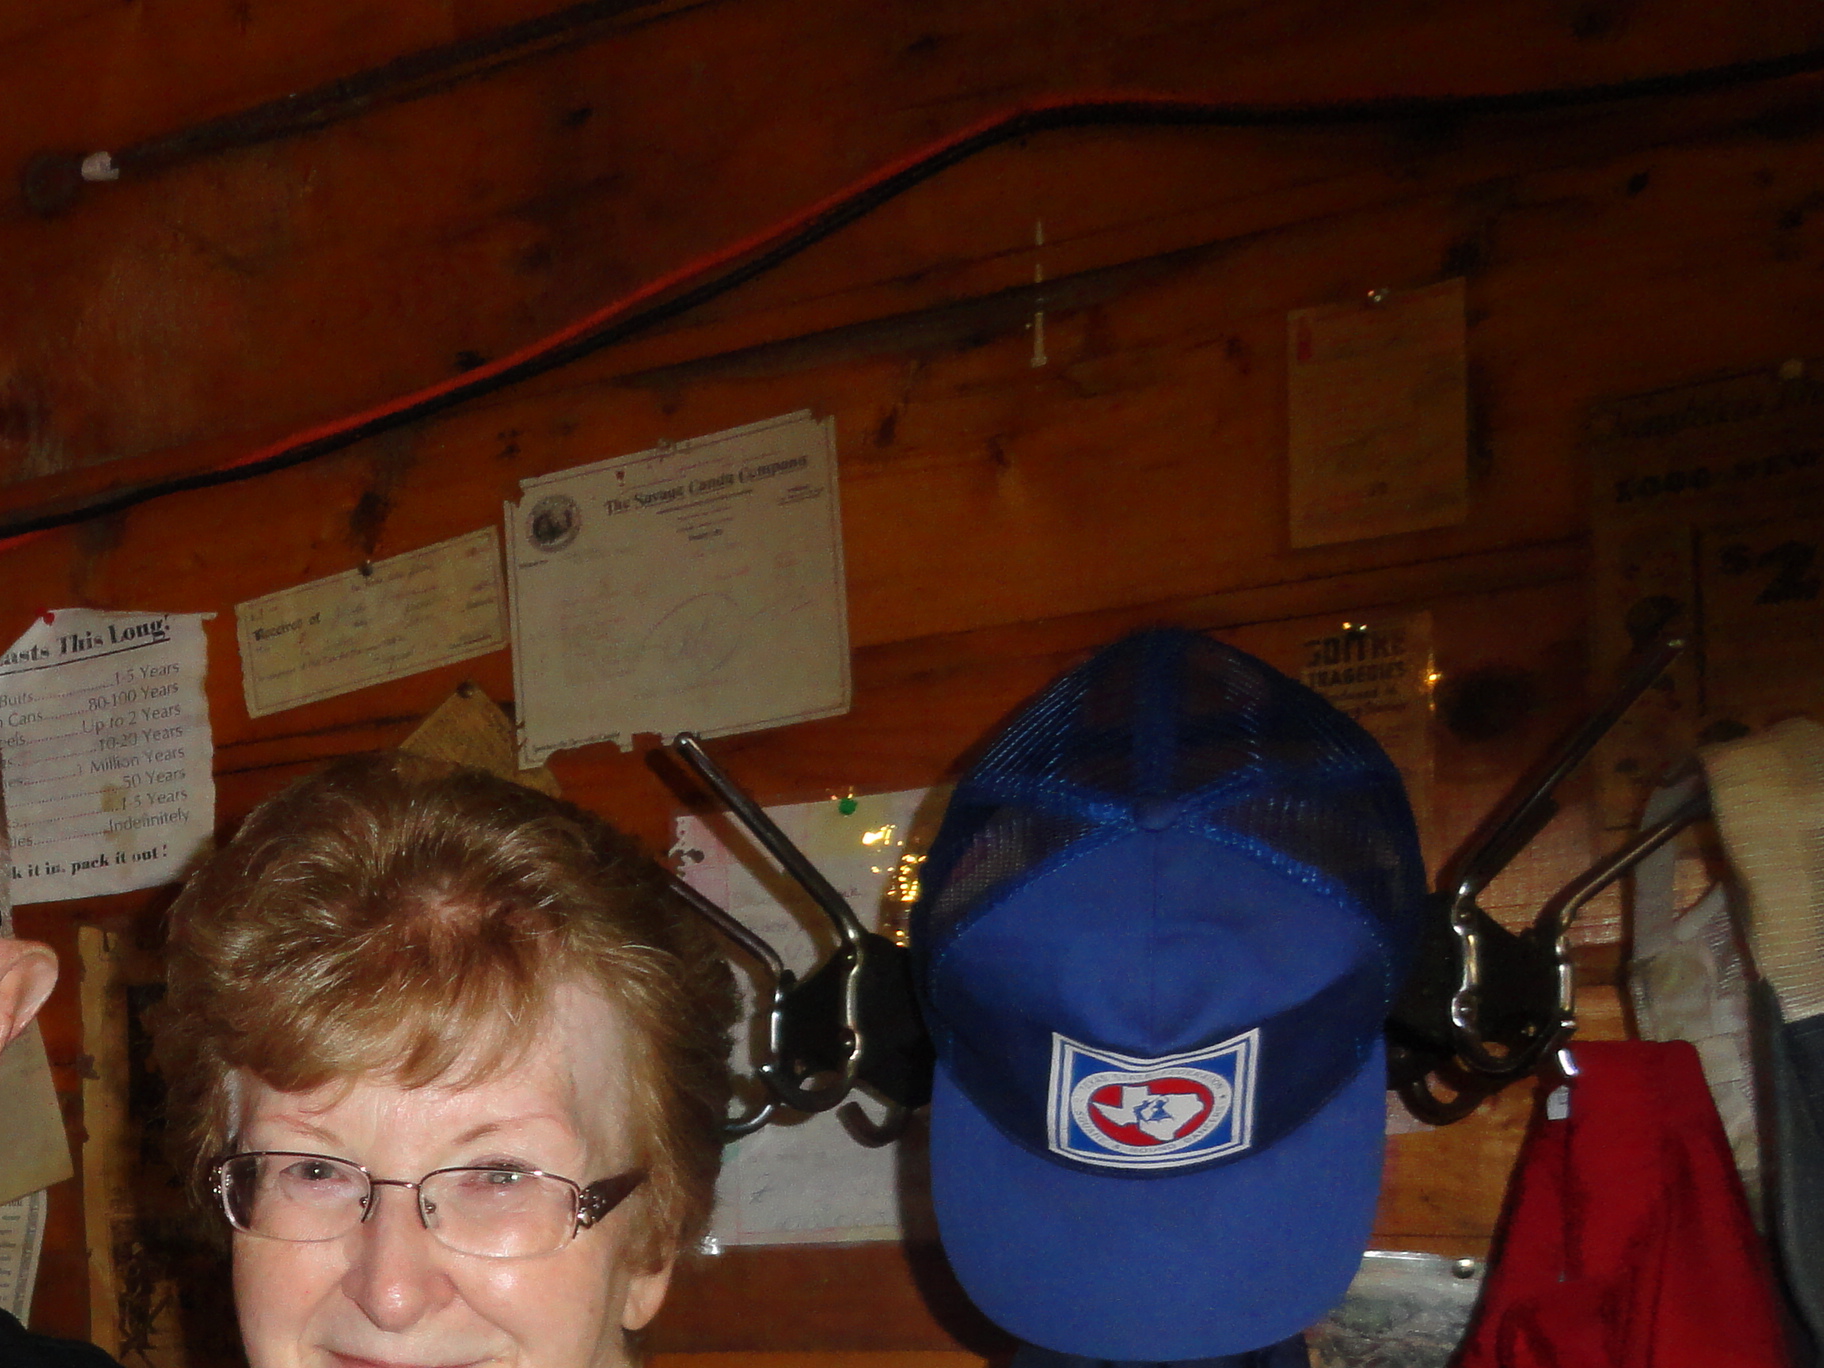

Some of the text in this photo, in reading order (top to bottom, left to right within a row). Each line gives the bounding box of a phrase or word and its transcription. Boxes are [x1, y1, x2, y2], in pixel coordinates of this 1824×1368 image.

[607, 500, 630, 516] The
[59, 615, 170, 656] This Long!
[139, 663, 179, 681] Years
[8, 684, 179, 727] Cans 80-100 Years
[82, 705, 181, 735] Up to 2 Years
[144, 726, 183, 744] Years
[90, 747, 185, 774] Million Years
[124, 769, 185, 789] 50 Years
[147, 790, 188, 807] Years
[109, 809, 189, 833] Indefinitely
[71, 854, 108, 875] pack
[116, 851, 127, 865] it
